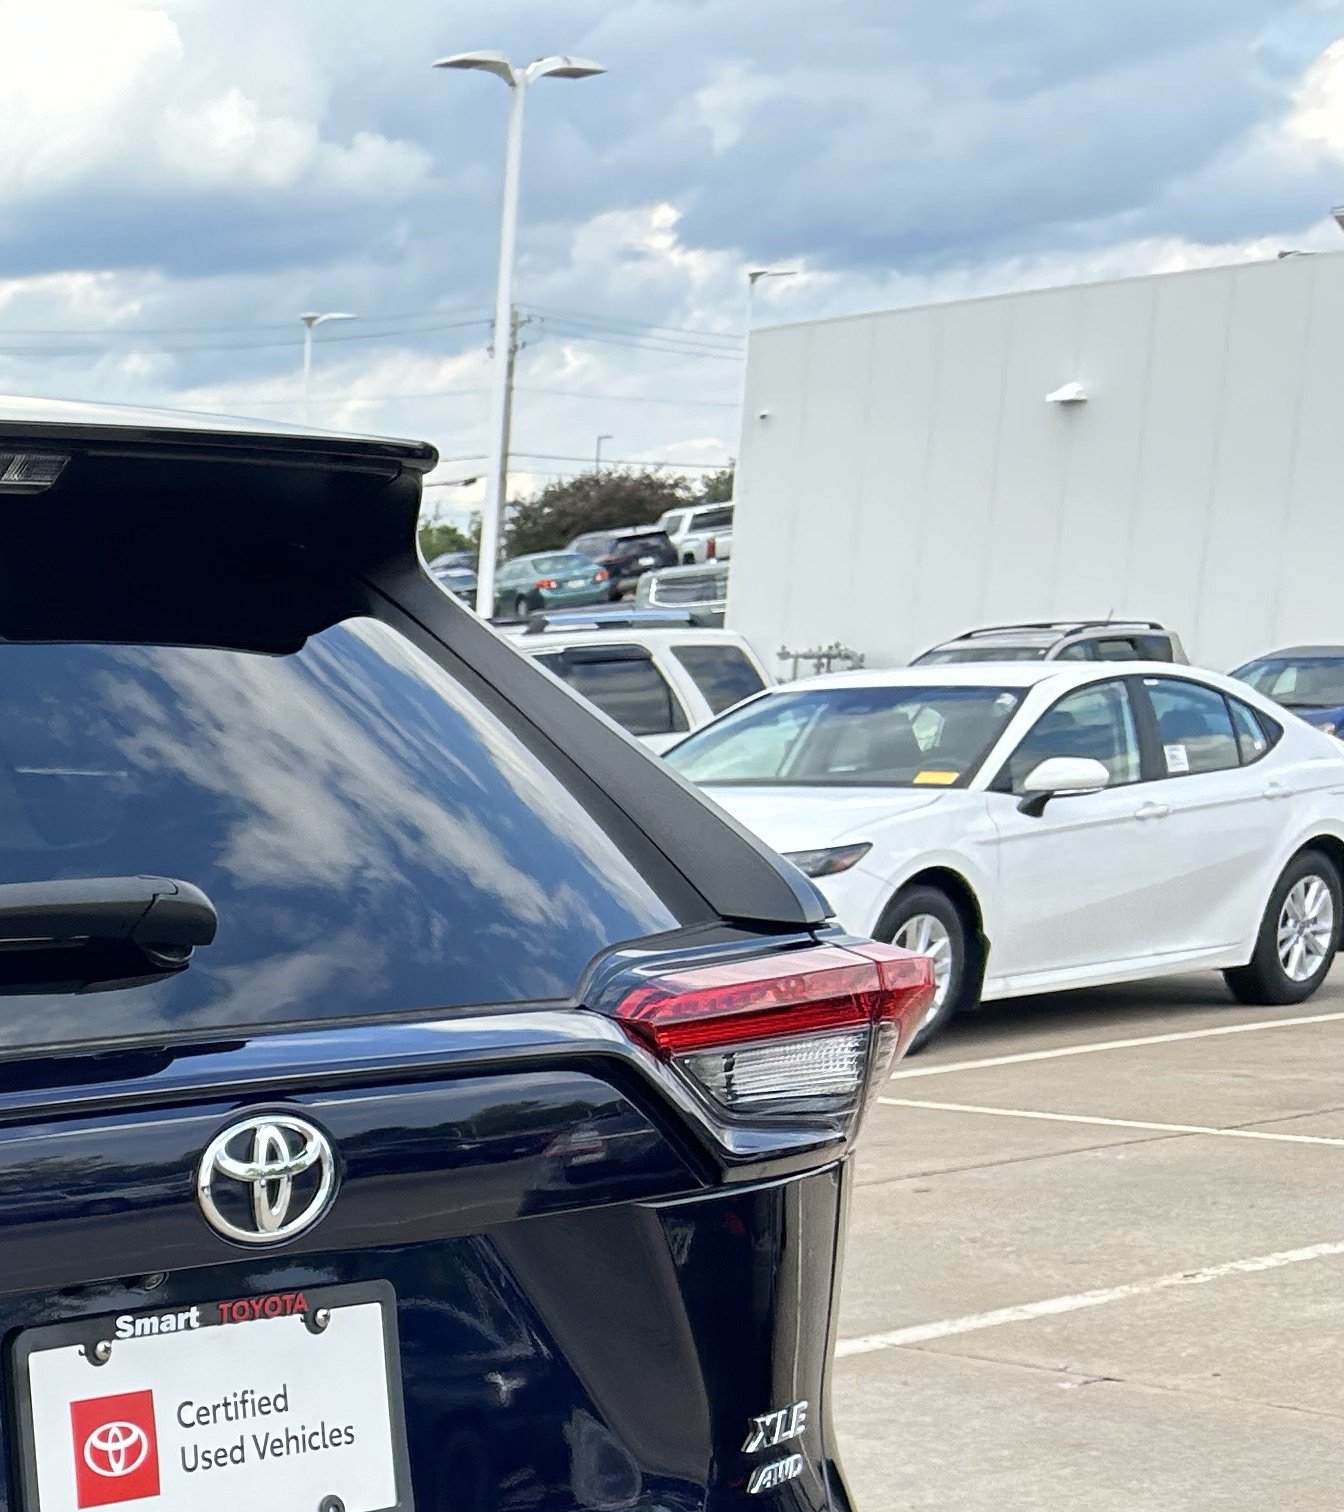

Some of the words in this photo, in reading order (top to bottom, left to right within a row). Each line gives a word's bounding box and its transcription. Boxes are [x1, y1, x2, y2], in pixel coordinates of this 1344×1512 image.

[115, 1306, 200, 1339] Smart
[217, 1292, 309, 1324] TOYOTA
[176, 1383, 289, 1428] Certified
[743, 1400, 808, 1453] XLE
[180, 1435, 245, 1473] Used
[252, 1422, 355, 1460] Vehicles
